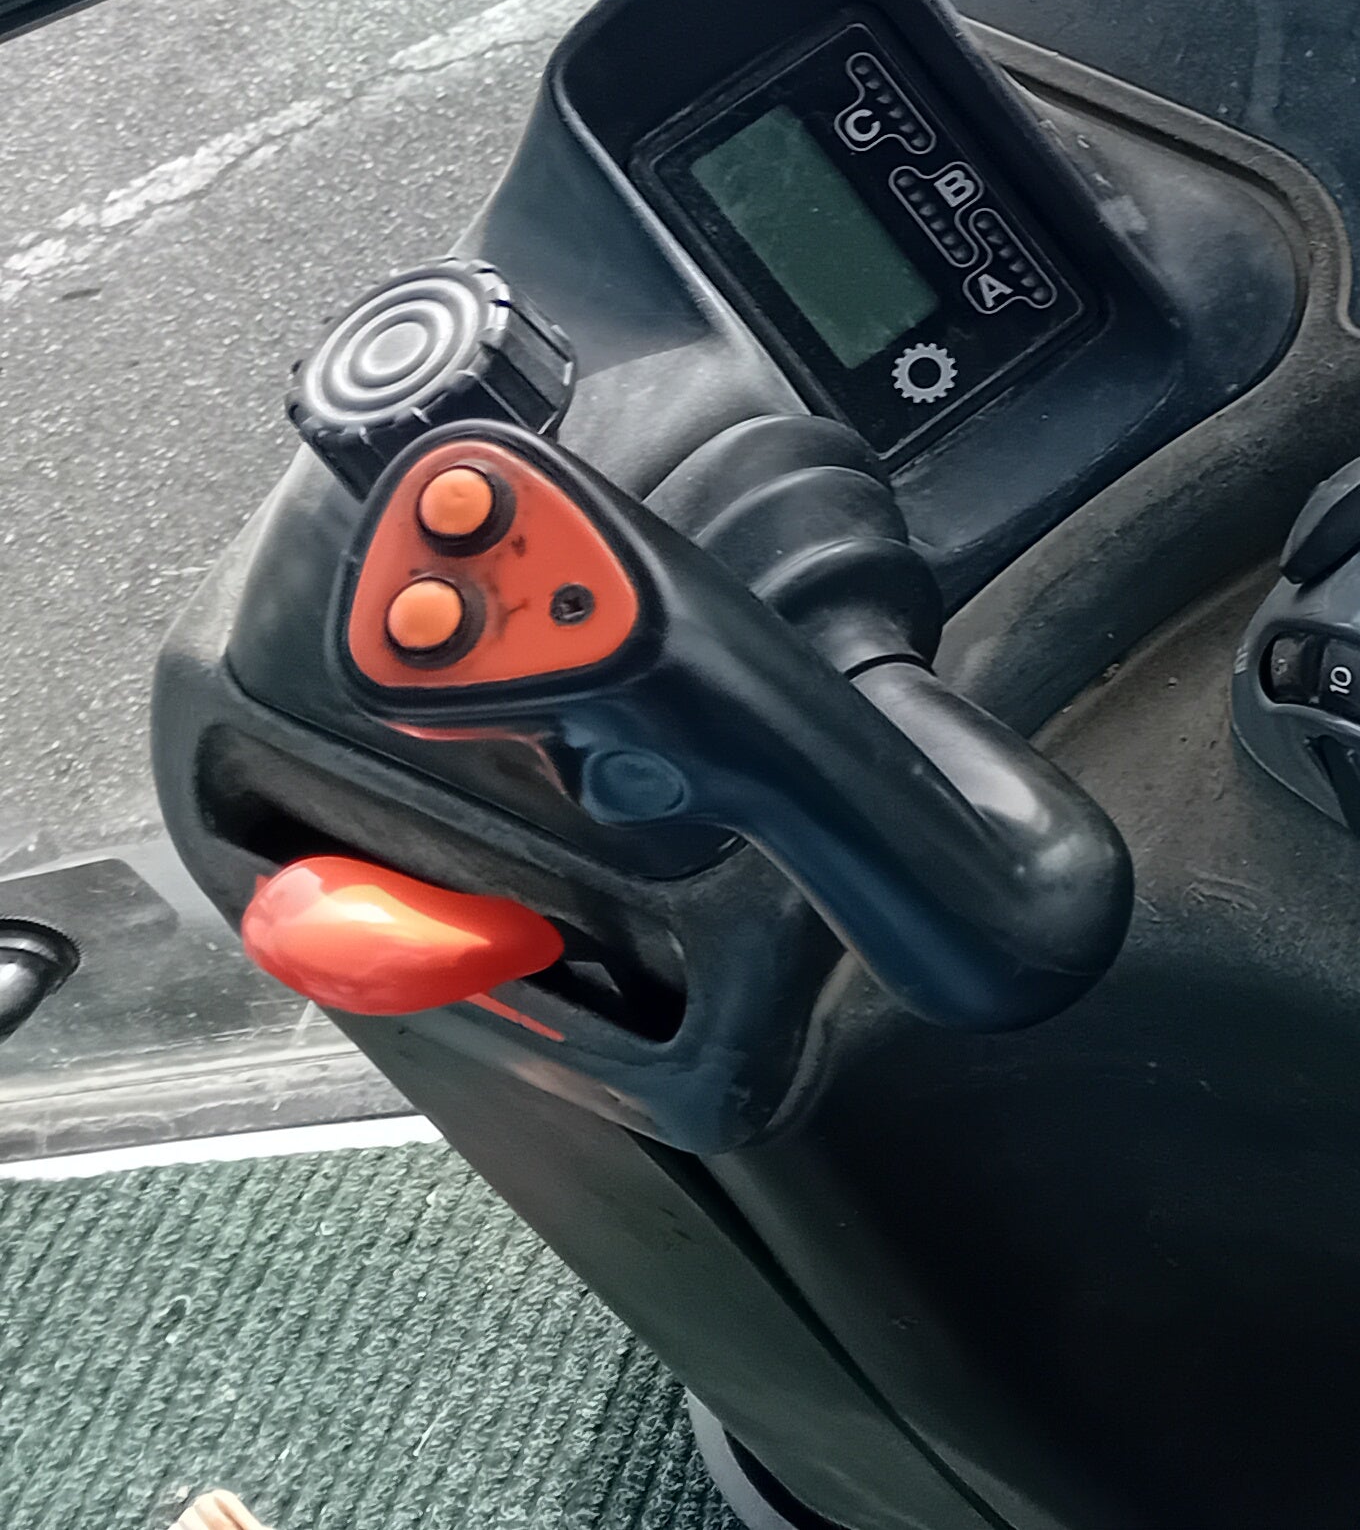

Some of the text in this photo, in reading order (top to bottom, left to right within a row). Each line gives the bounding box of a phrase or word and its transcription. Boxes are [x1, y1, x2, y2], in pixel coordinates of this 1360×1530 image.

[845, 109, 881, 142] C
[933, 170, 977, 206] B
[976, 273, 1013, 307] A
